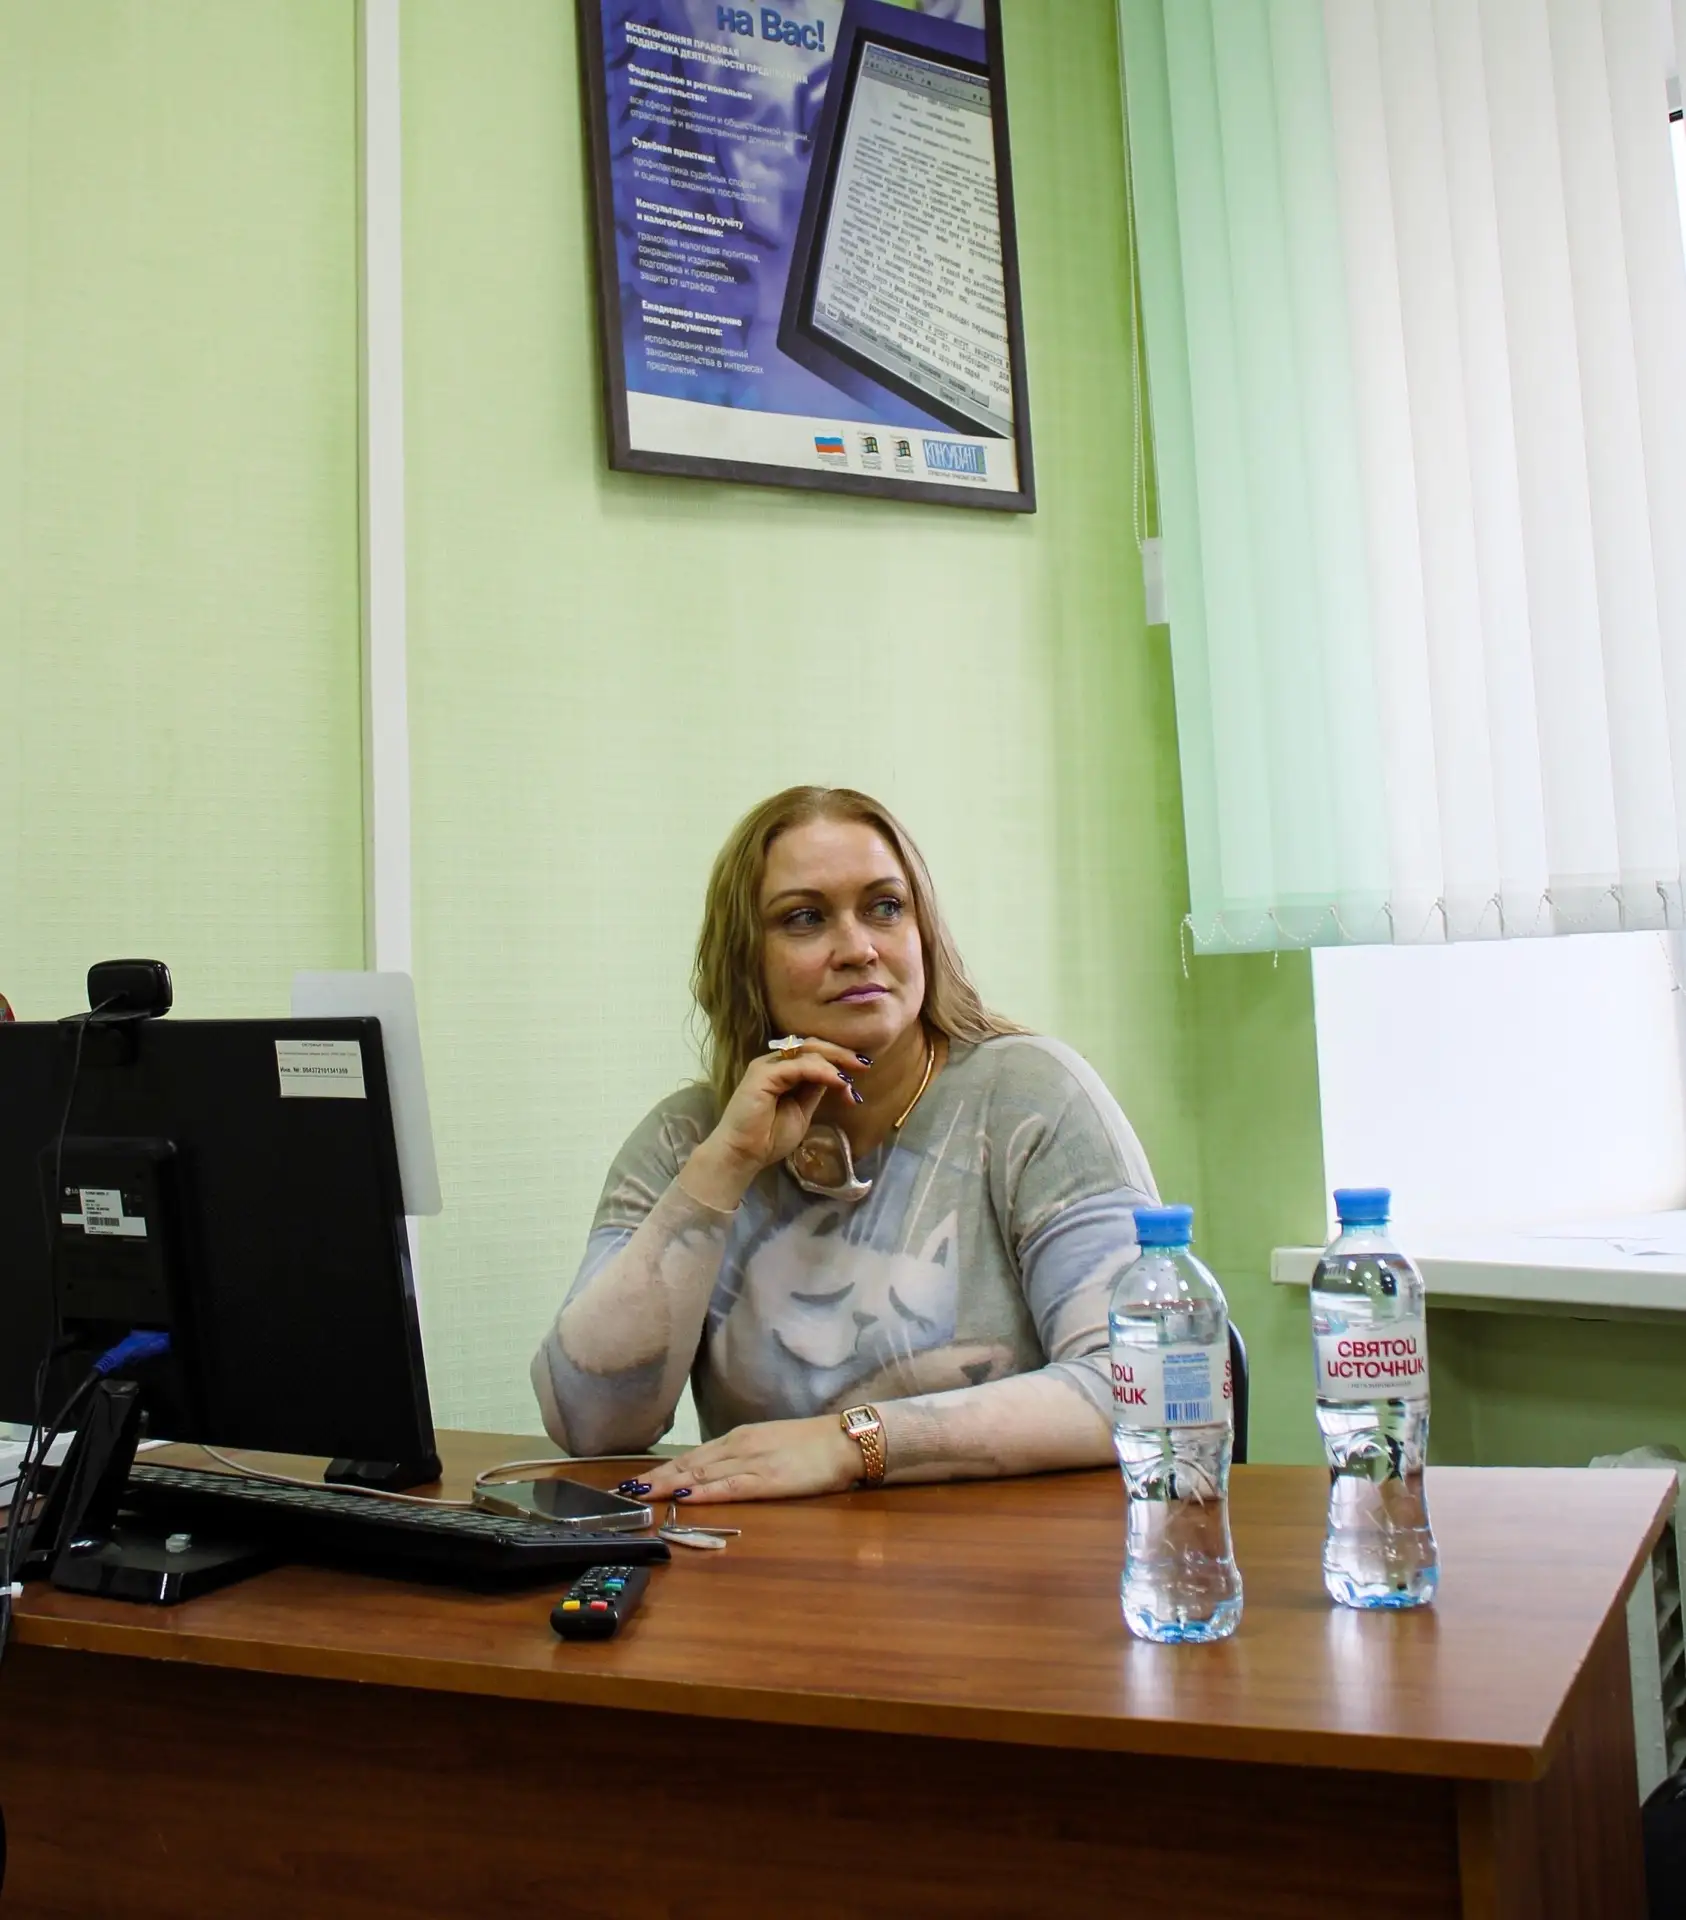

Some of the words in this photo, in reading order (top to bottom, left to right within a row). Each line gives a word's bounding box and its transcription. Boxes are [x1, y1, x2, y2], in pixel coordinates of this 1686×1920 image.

[625, 22, 693, 47] ВСЕСТОРОННЯЯ
[694, 41, 740, 57] ПРАВОВАЯ
[717, 5, 754, 37] на
[760, 7, 825, 52] Вас!
[626, 35, 679, 56] ПОДДЕРЖКА
[680, 49, 745, 70] ДЕЯТЕЛЬНОСТИ
[628, 63, 685, 85] Федеральное
[693, 82, 752, 100] региональное
[629, 78, 707, 103] законодательство:
[630, 97, 643, 106] все
[645, 100, 671, 115] сферы
[674, 106, 715, 122] экономики
[725, 118, 780, 136] общественной
[630, 110, 677, 127] отраслевые
[632, 137, 672, 156] Судебная
[674, 149, 715, 163] практика:
[633, 157, 688, 177] профилактика
[691, 170, 727, 185] судебных
[641, 172, 668, 186] оценка
[671, 180, 716, 195] возможных
[636, 198, 693, 219] Консультации
[695, 213, 705, 221] по
[707, 214, 743, 230] бухучёту
[644, 216, 723, 237] налогообложению:
[638, 232, 678, 248] грамотная
[680, 240, 720, 255] налоговая
[638, 245, 686, 262] сокращение
[688, 257, 728, 270] издержек,
[639, 259, 682, 275] подготовка
[691, 270, 736, 284] проверкам,
[640, 272, 668, 286] защита
[642, 300, 693, 319] Ежедневное
[695, 312, 742, 326] включение
[643, 315, 669, 327] новых
[671, 322, 722, 336] документов:
[645, 335, 703, 352] использование
[706, 345, 748, 358] изменений
[646, 348, 715, 367] законодательства
[724, 362, 764, 374] интересах
[1338, 1335, 1416, 1357] СВЯТОЙ
[1328, 1357, 1425, 1378] ИСТОЧНИК
